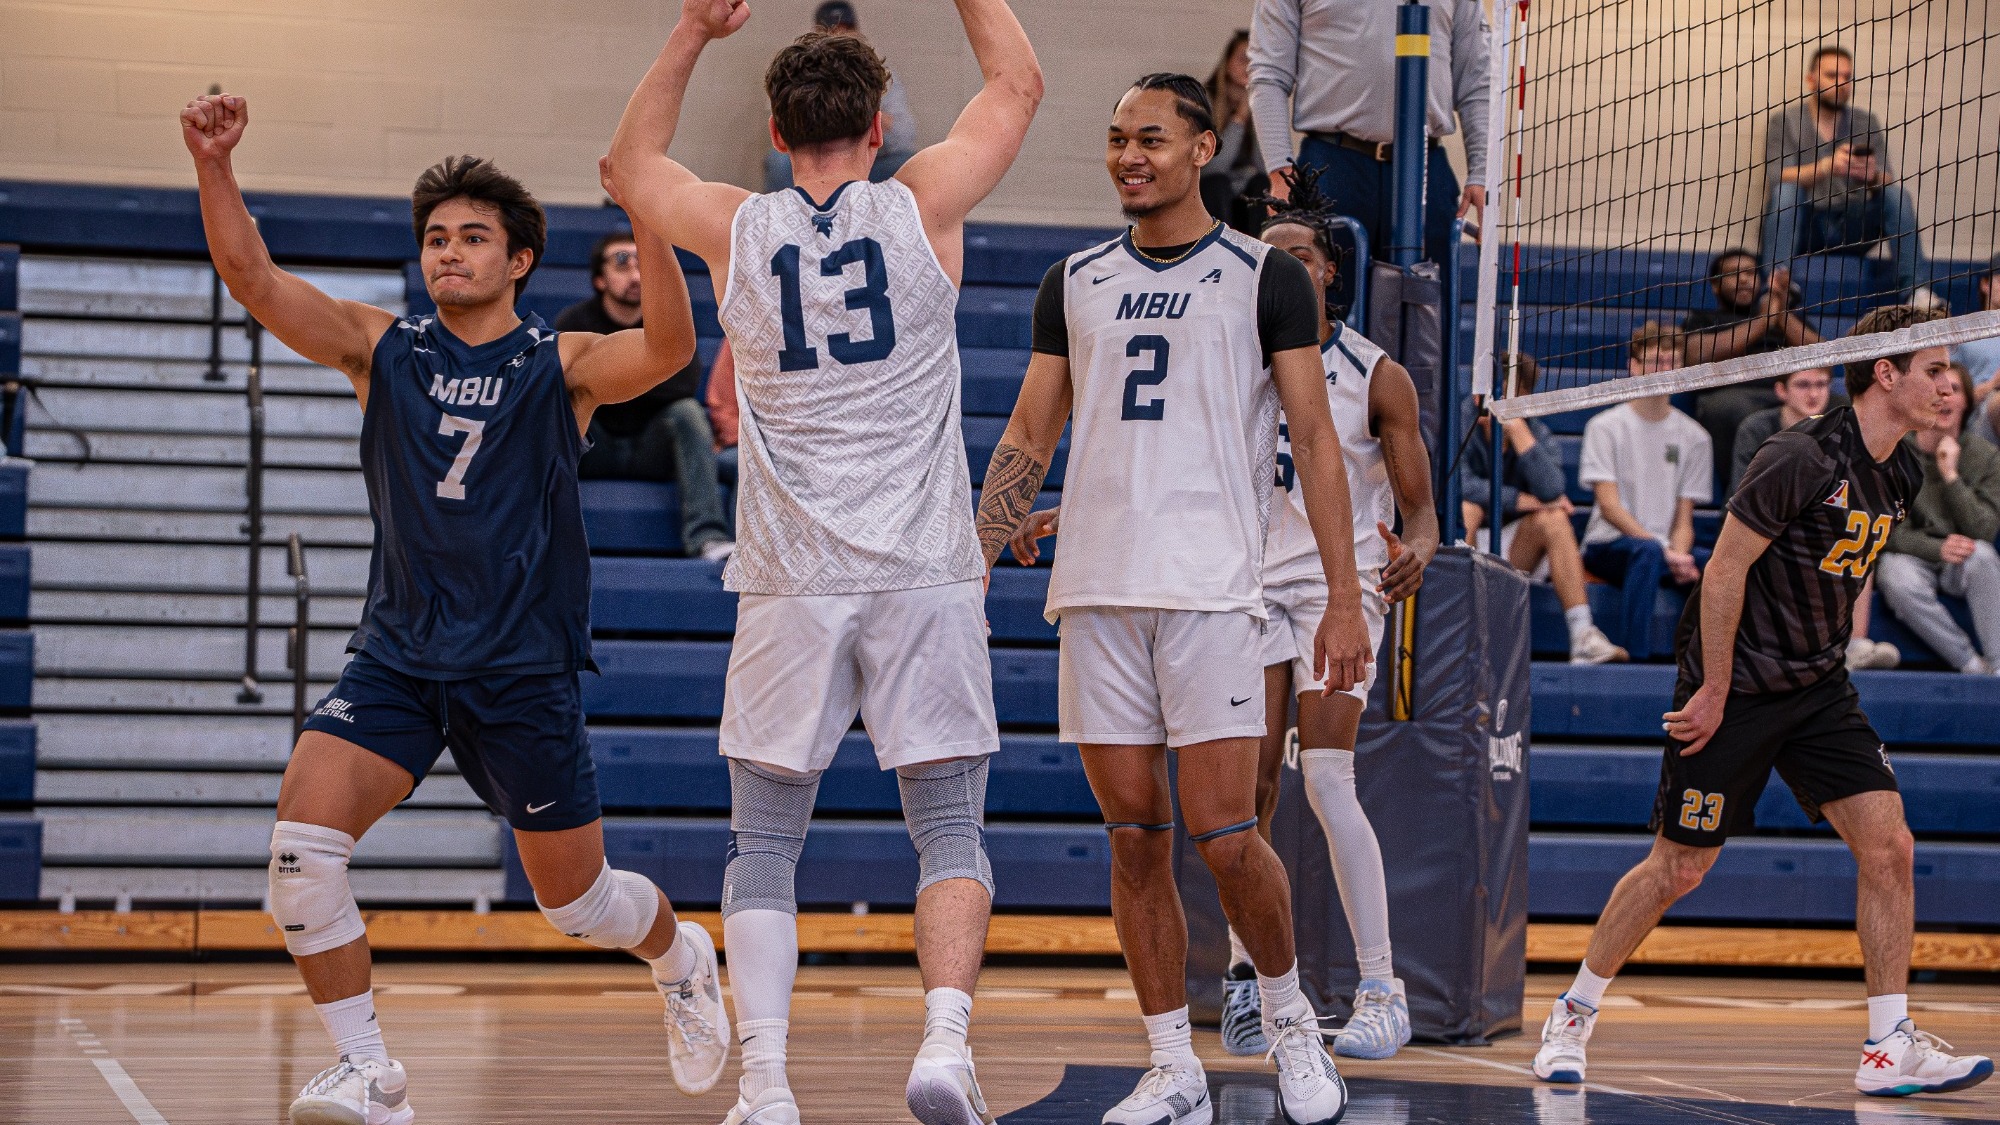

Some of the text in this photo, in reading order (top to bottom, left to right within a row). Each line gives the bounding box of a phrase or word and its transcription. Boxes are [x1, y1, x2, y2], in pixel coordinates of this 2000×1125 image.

[770, 237, 896, 373] 13
[1115, 293, 1192, 320] MBU
[428, 373, 503, 406] MBU
[1121, 335, 1170, 421] 2
[436, 411, 486, 500] 7
[1819, 510, 1893, 578] 23
[1679, 788, 1725, 831] 23
